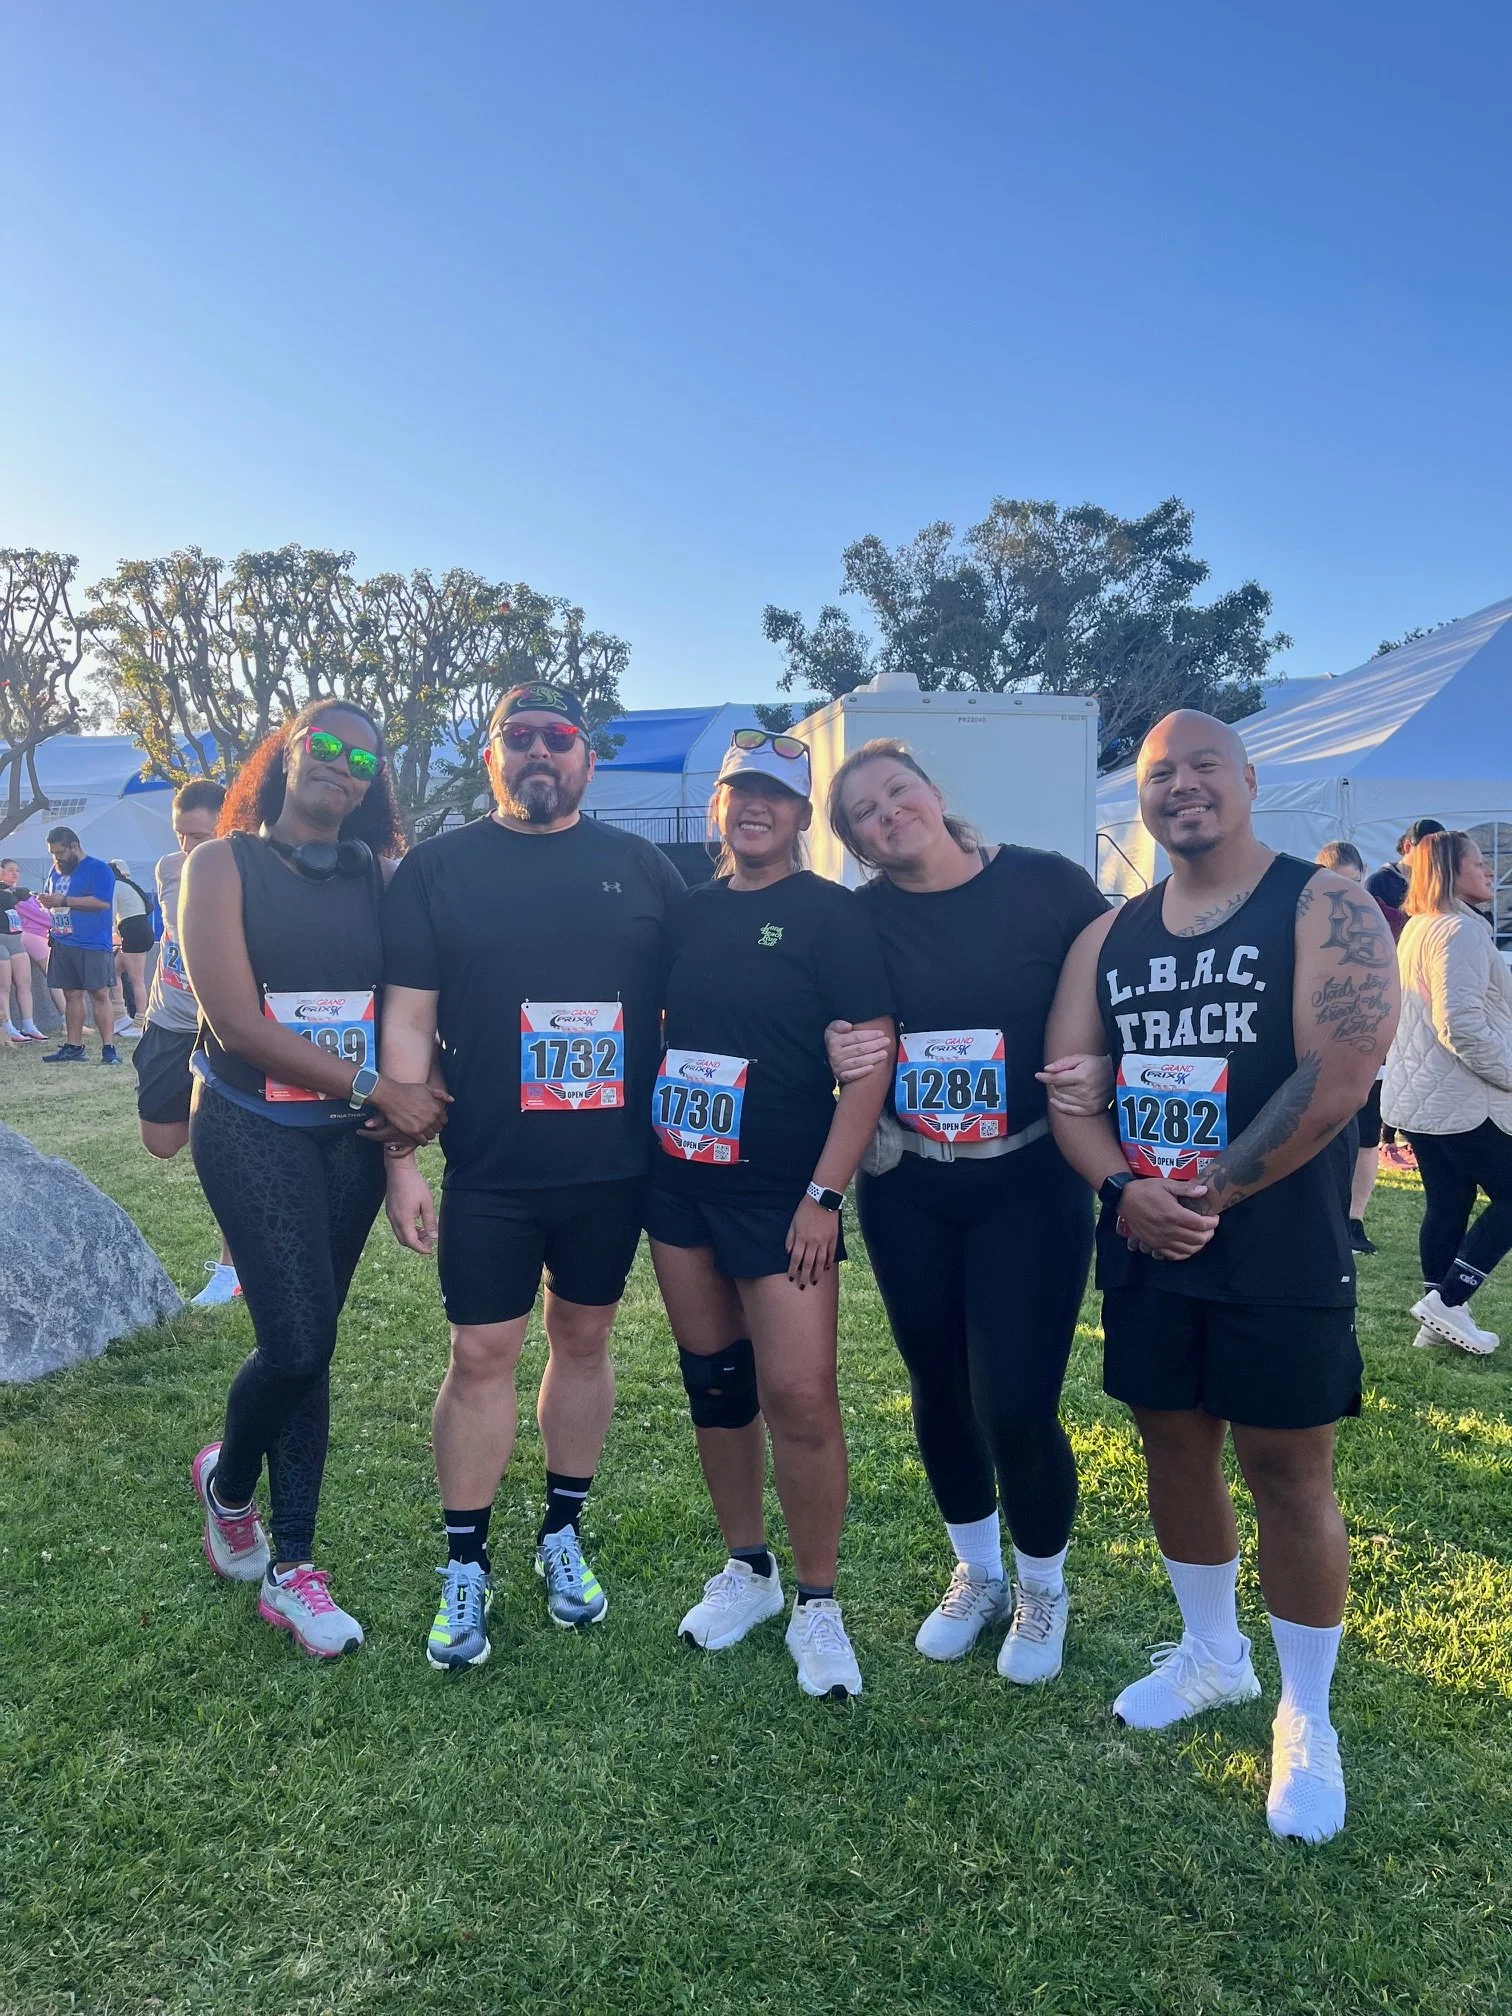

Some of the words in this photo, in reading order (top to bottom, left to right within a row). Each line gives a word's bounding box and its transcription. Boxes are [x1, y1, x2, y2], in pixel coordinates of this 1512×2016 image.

[52, 915, 70, 926] 1313
[1106, 945, 1267, 1007] L.B.A.C.
[316, 998, 346, 1006] GRAND
[1115, 1001, 1258, 1052] TRACK
[945, 1037, 974, 1045] GRAND
[528, 1037, 617, 1080] 1732
[696, 1059, 721, 1068] GRAND
[1161, 1064, 1195, 1073] GRAND
[901, 1067, 1001, 1111] 1284
[567, 1091, 584, 1099] OPEN
[658, 1084, 736, 1135] 1730
[1121, 1094, 1220, 1146] 1282
[942, 1123, 959, 1131] OPEN
[683, 1141, 697, 1149] OPEN
[1157, 1157, 1175, 1166] OPEN
